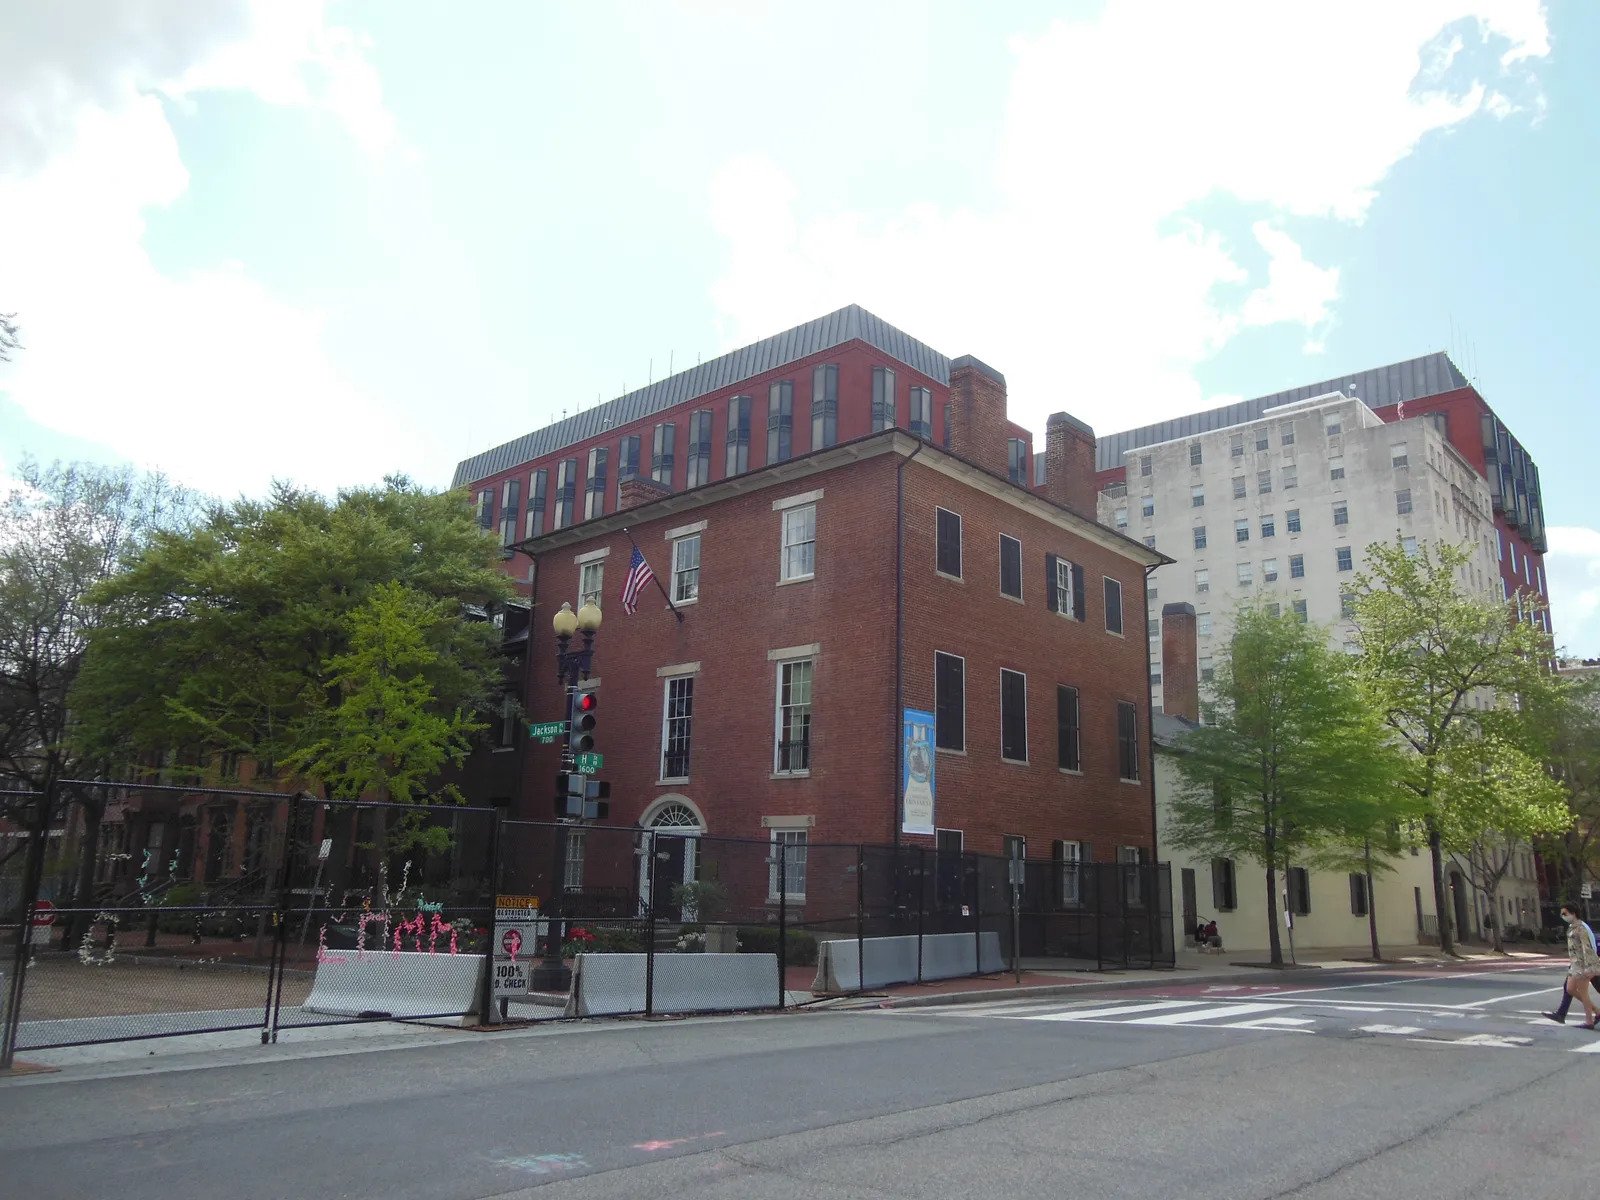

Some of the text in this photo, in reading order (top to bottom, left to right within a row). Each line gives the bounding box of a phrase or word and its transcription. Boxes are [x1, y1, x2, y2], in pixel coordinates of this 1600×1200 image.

[532, 724, 558, 736] Jackson
[541, 736, 553, 744] 700
[581, 754, 587, 764] H
[579, 765, 595, 774] 1600
[498, 898, 531, 907] NOTICE
[497, 965, 523, 977] 100%
[504, 979, 527, 989] CHECK
